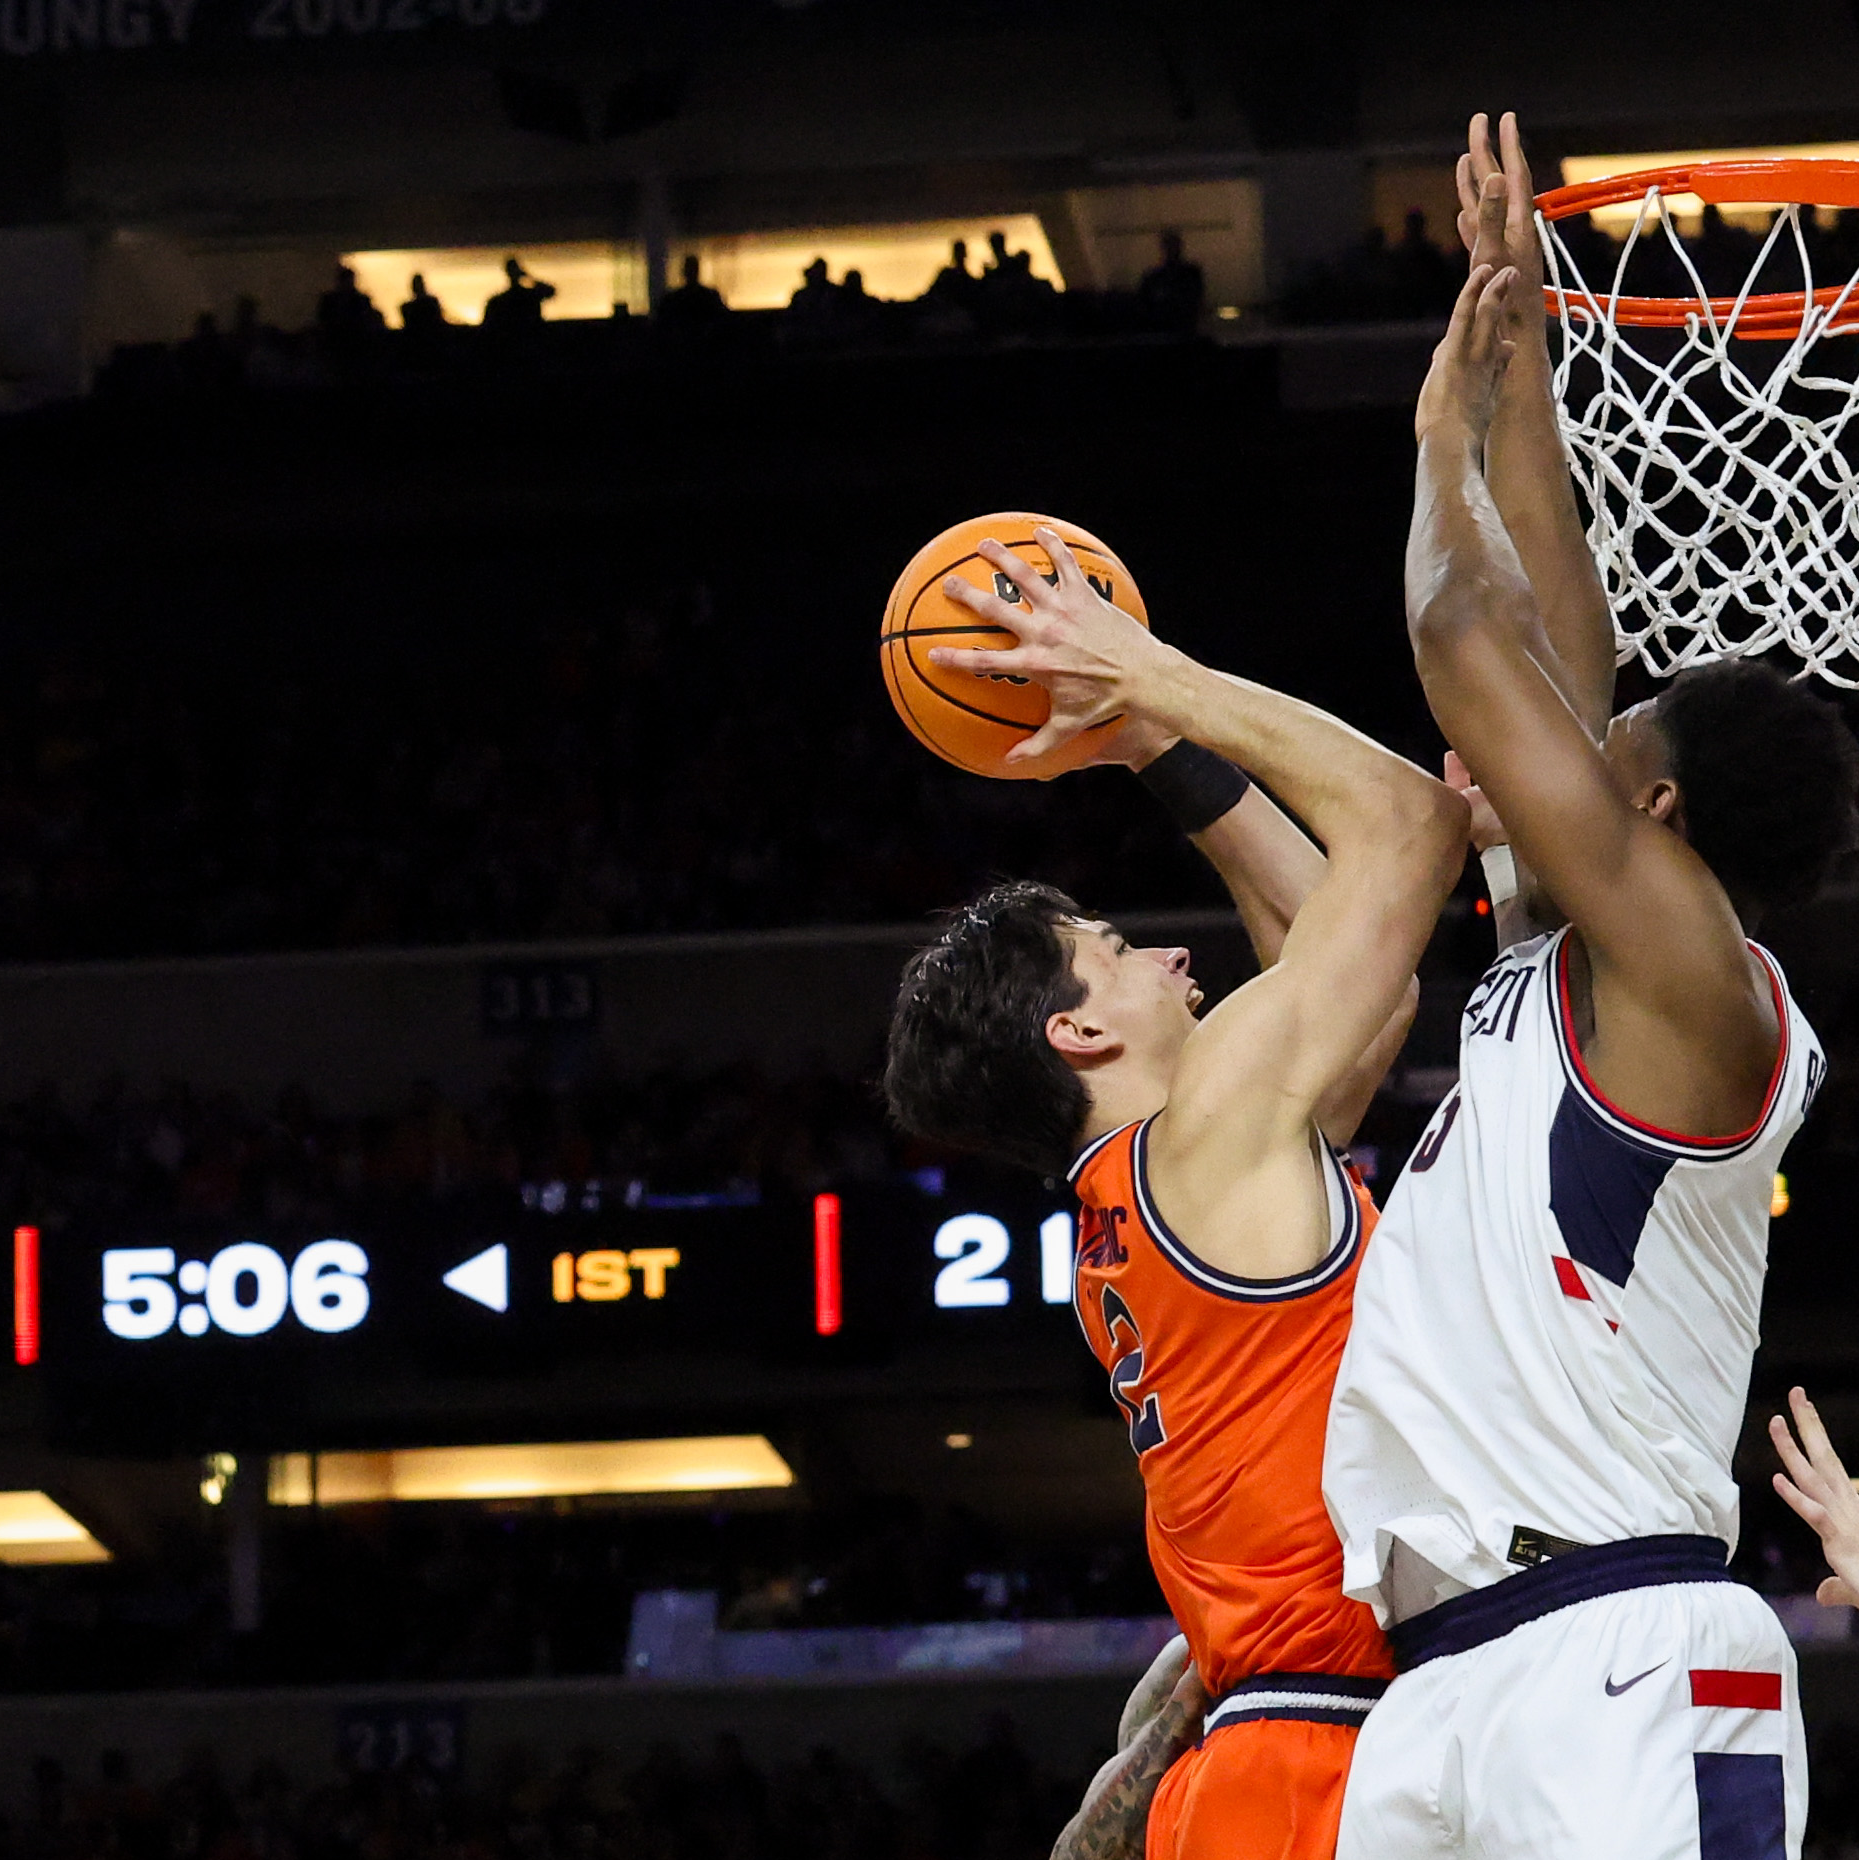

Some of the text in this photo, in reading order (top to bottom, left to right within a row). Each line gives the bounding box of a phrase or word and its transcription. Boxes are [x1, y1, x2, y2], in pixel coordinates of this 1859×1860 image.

[101, 1239, 371, 1340] 5:06
[551, 1247, 681, 1303] 1ST
[933, 1211, 1074, 1309] 21
